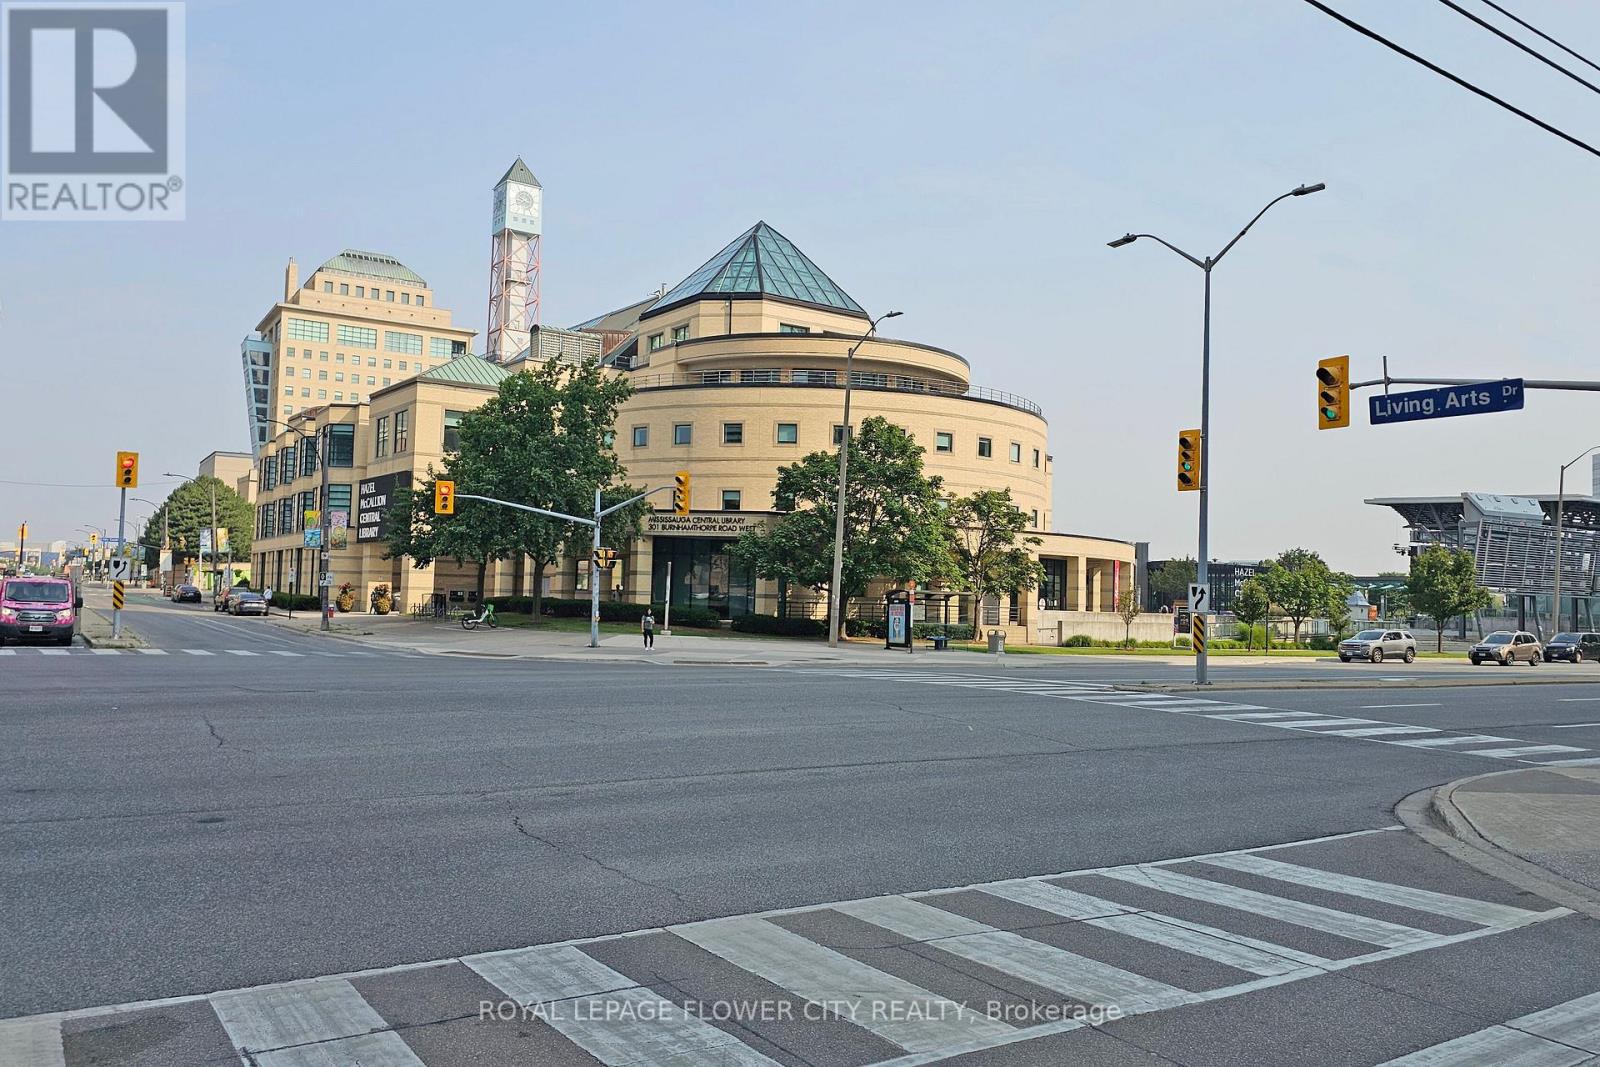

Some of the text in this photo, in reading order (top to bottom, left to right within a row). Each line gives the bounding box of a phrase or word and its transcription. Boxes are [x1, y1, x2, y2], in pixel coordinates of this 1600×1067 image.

[1375, 385, 1518, 417] Living Arts Dr
[361, 482, 376, 495] HAZEL
[360, 495, 386, 509] McCALLION
[360, 511, 380, 524] CENTRAL
[648, 516, 746, 525] MISSISSAUGA CENTRAL LIBRARY
[359, 526, 379, 539] LIBRARY
[661, 524, 717, 532] BURNHAMTHORPE
[718, 524, 737, 532] ROAD
[1234, 567, 1256, 577] HAZEL
